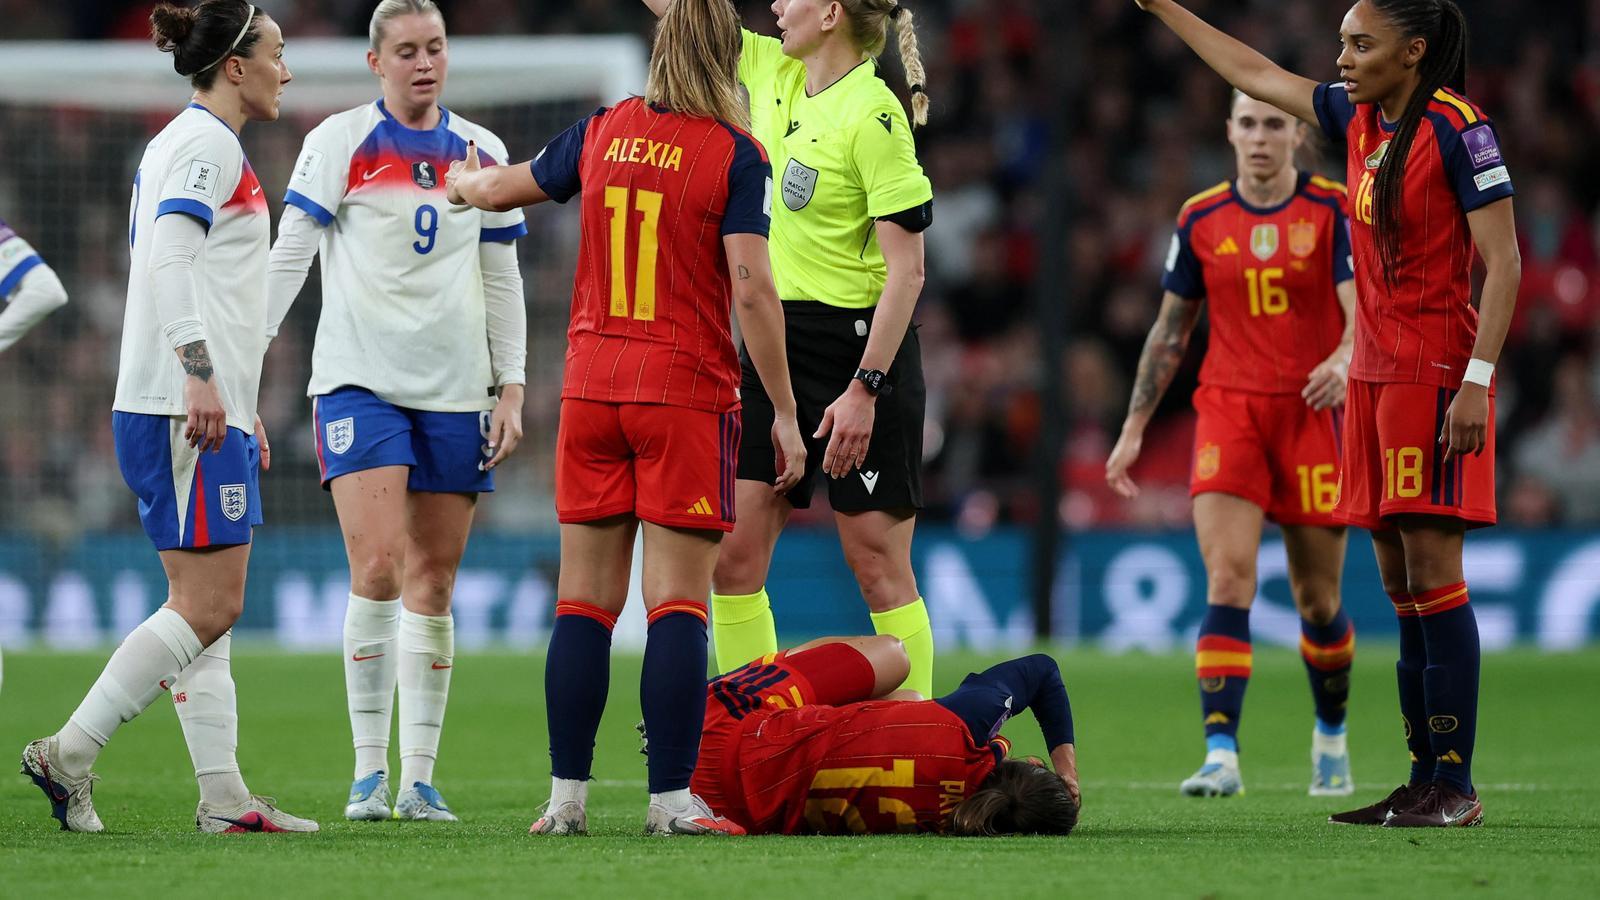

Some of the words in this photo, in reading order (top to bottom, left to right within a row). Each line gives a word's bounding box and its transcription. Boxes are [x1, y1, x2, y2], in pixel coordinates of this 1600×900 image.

[603, 137, 683, 172] ALEXIA
[790, 166, 808, 181] UEFA
[784, 186, 806, 201] OFFICIAL
[788, 180, 806, 192] MATCH
[413, 204, 438, 254] 9
[604, 185, 664, 322] 11
[1244, 268, 1289, 317] 16
[1296, 463, 1338, 513] 16
[1385, 446, 1424, 500] 18
[804, 758, 917, 834] 12
